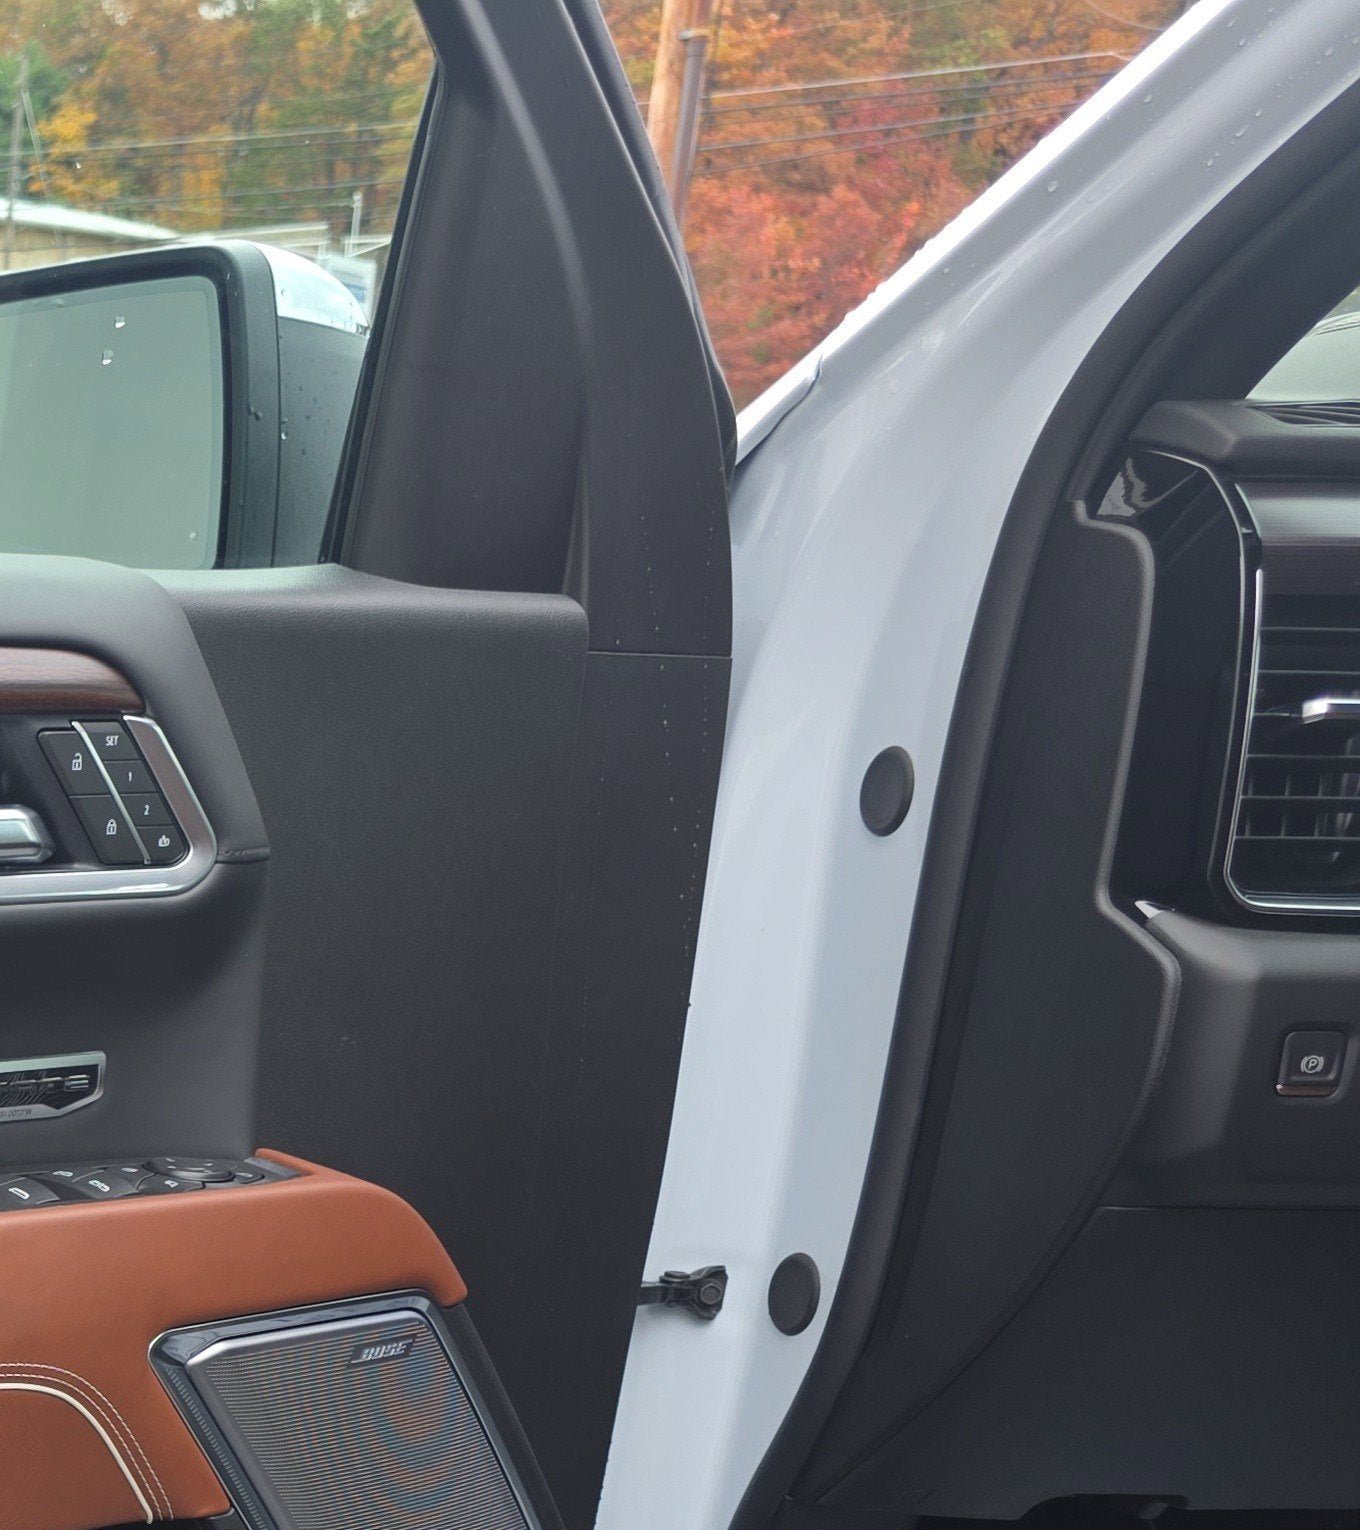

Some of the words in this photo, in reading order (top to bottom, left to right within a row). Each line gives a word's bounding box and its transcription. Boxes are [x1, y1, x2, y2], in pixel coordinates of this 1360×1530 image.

[105, 734, 119, 747] SET
[128, 771, 133, 782] 1
[144, 804, 150, 816] 2
[354, 1341, 410, 1362] BOSE
